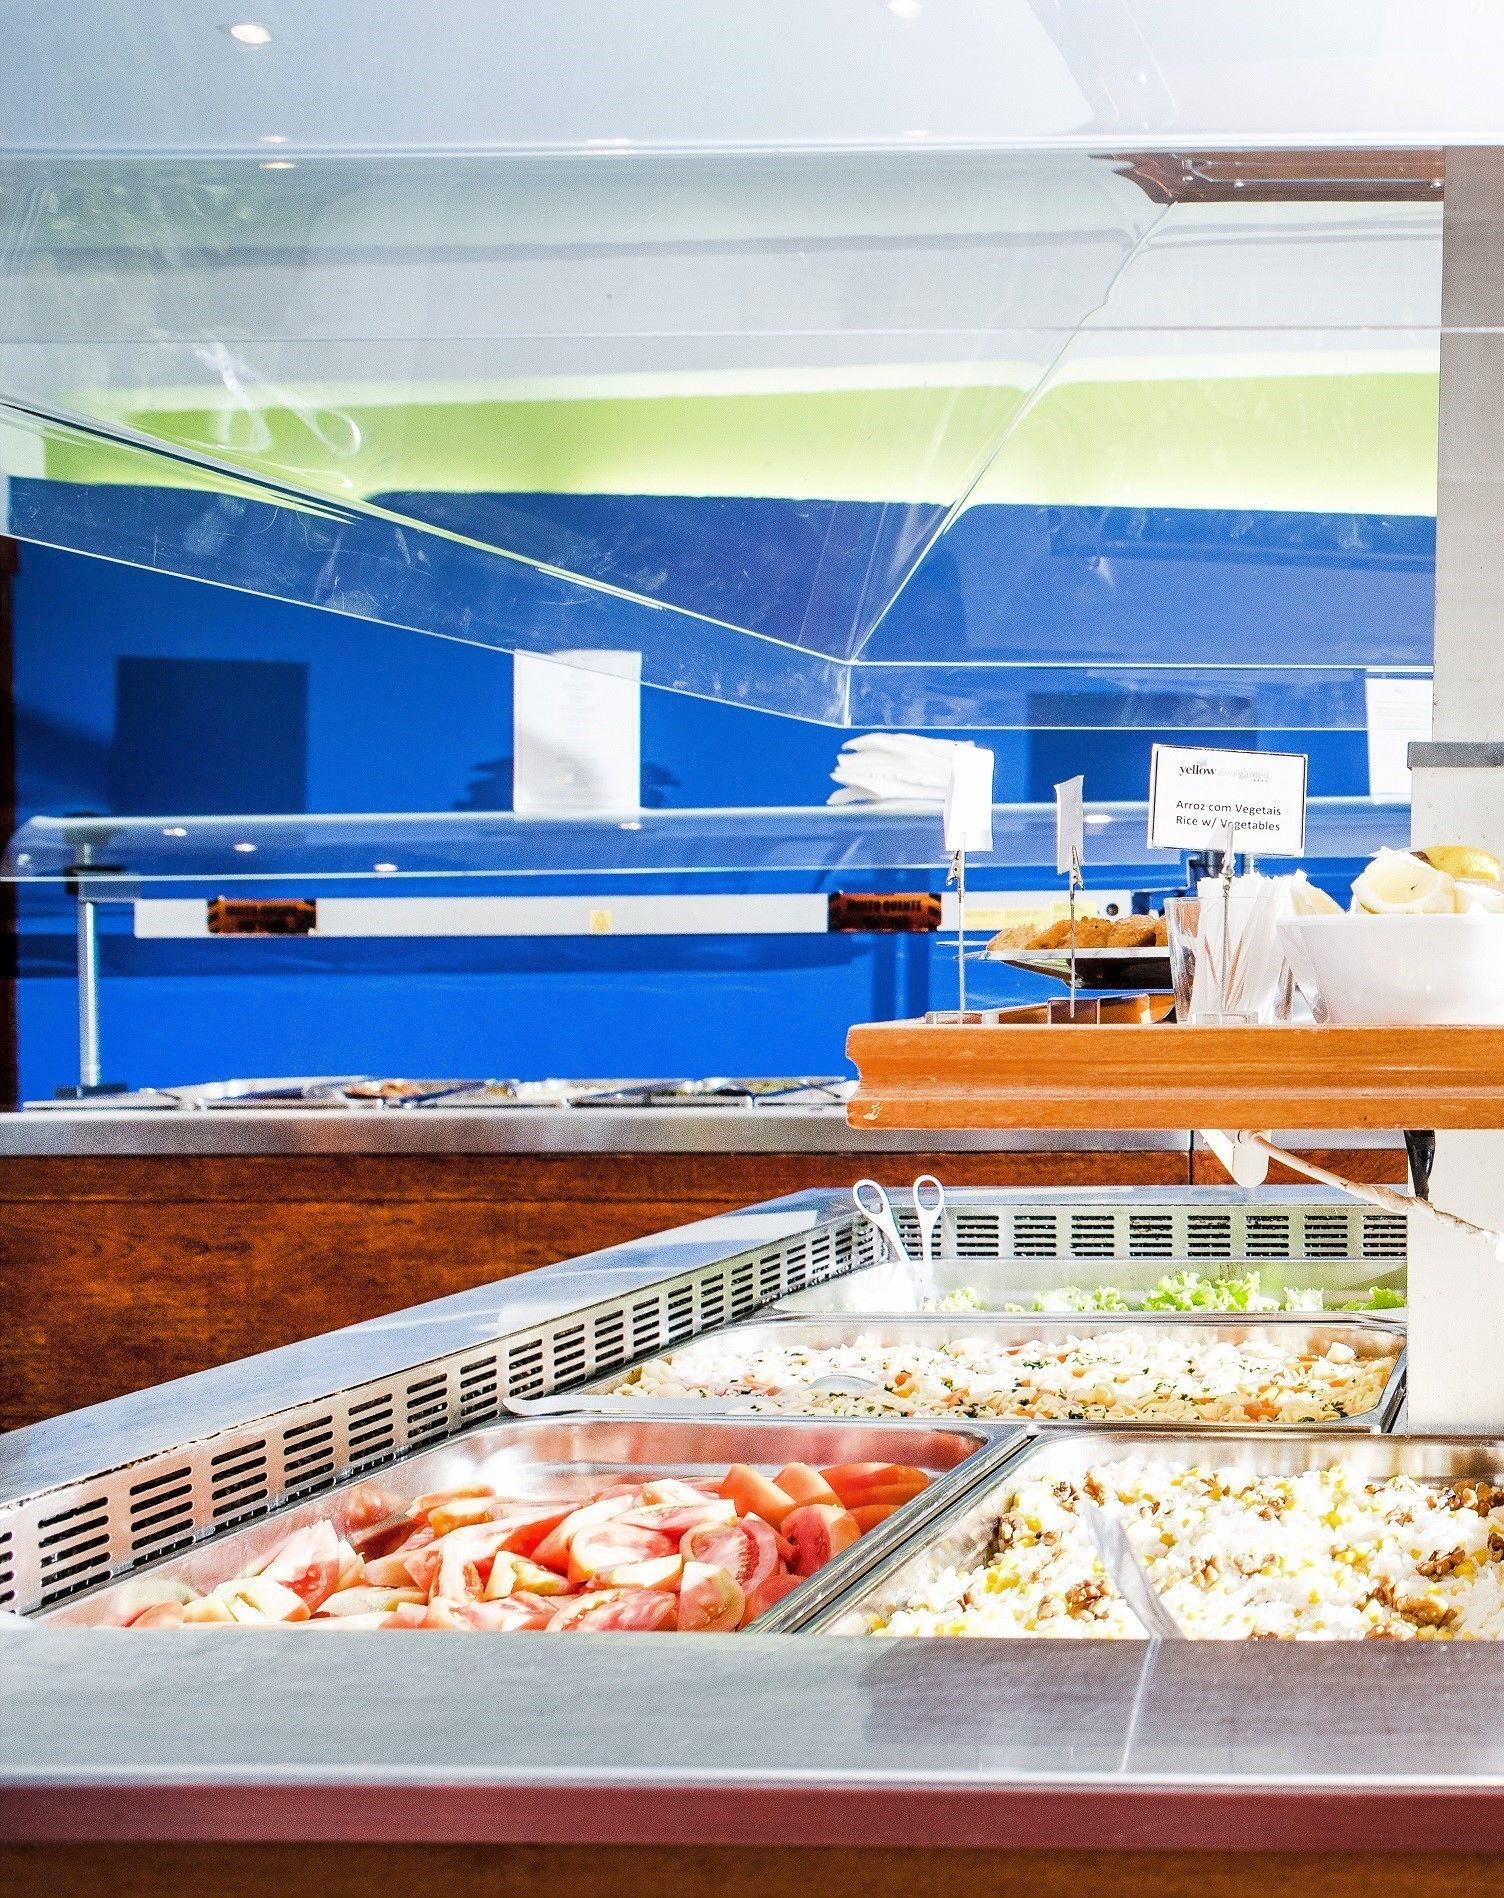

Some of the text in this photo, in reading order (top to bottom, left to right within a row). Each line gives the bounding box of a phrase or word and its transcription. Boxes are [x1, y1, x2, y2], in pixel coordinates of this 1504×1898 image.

[1179, 764, 1216, 776] yellow
[1176, 800, 1282, 816] Arroz com Vegetais
[1176, 815, 1198, 826] Rice
[1201, 818, 1217, 828] w/
